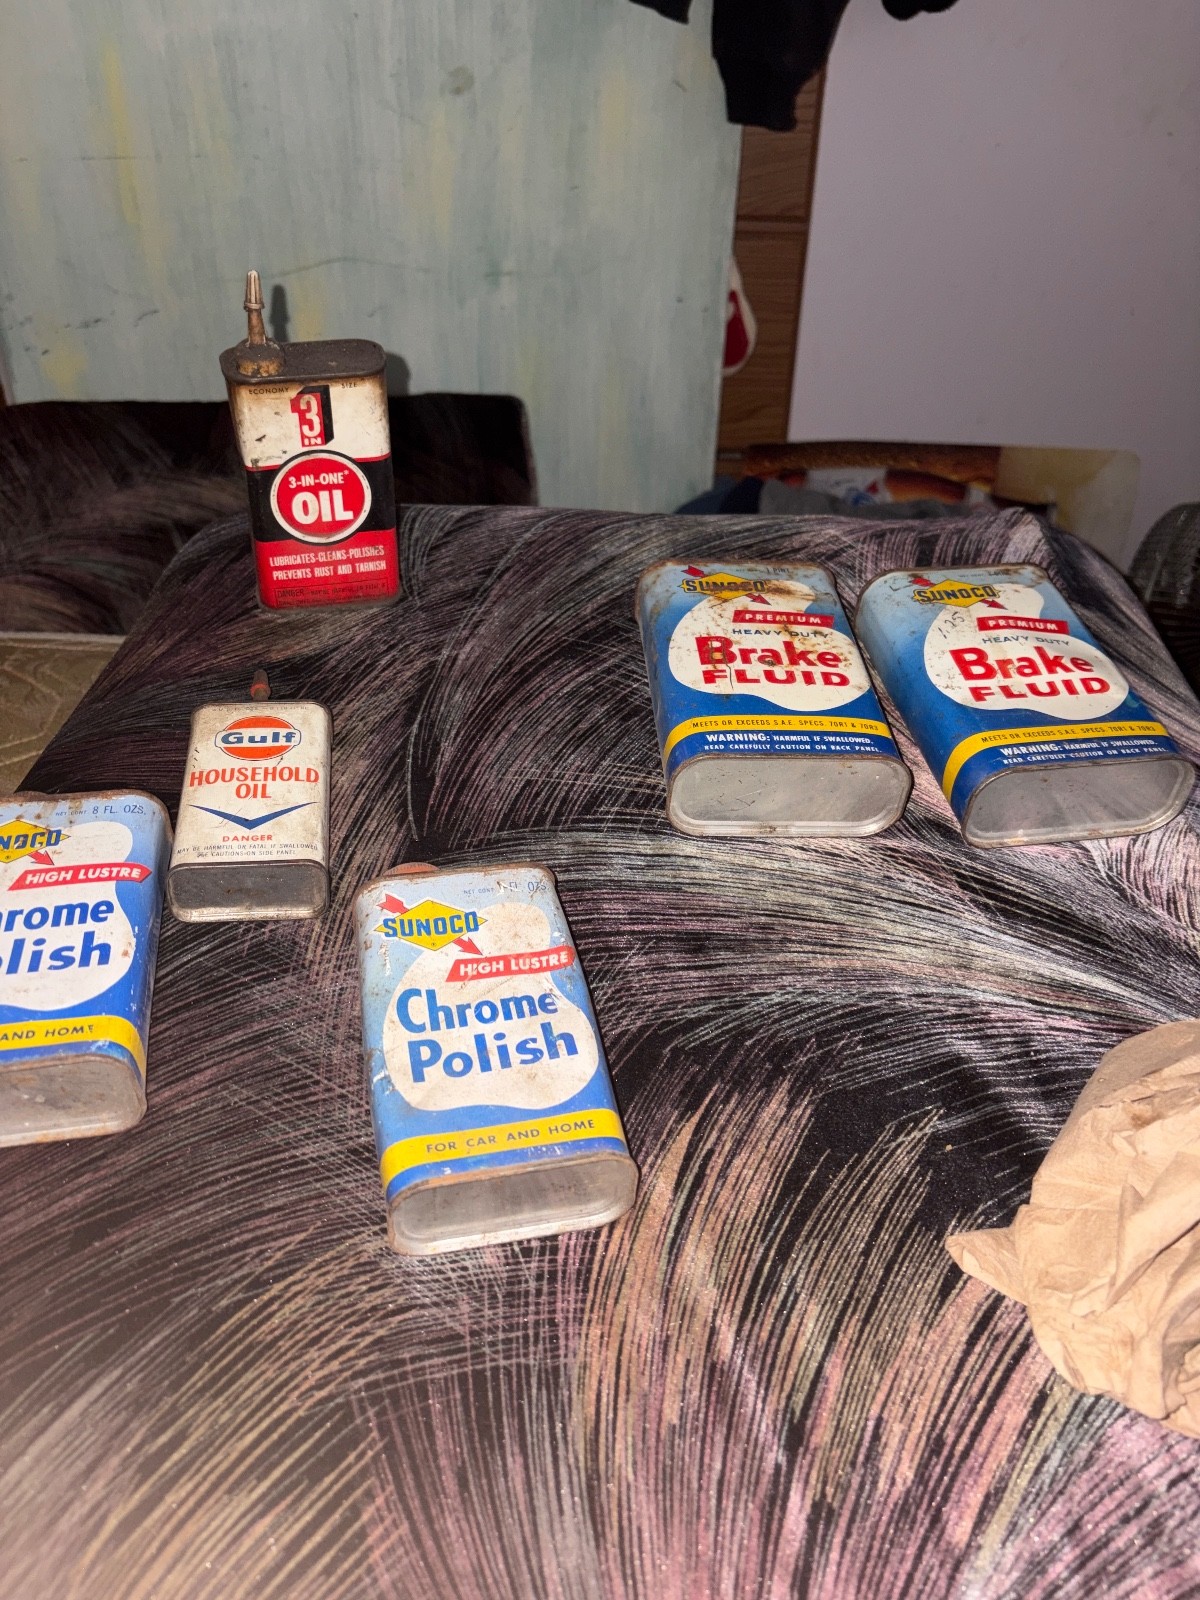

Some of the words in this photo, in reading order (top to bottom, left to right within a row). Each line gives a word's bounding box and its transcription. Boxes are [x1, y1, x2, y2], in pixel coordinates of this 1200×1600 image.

[248, 387, 290, 395] ECONOMY
[303, 438, 322, 446] IN
[291, 489, 354, 525] OIL
[272, 568, 312, 581] PREVENTS
[314, 565, 334, 578] RUST
[337, 564, 352, 575] AND
[355, 560, 387, 573] TARNISH
[683, 578, 767, 593] SUNOCO
[915, 584, 997, 602] SUNOCO
[745, 613, 822, 624] PREMIUM
[988, 618, 1059, 631] PREMIUM
[732, 628, 782, 637] HEAVY
[789, 630, 829, 639] DUTY
[982, 635, 1029, 645] HEAVY
[1034, 636, 1070, 647] DUTY
[695, 635, 842, 669] Brake
[949, 645, 1095, 681] Brake
[702, 669, 850, 687] FLUID
[967, 677, 1111, 702] FLUID
[692, 720, 719, 729] MEETS
[221, 731, 297, 745] Gulf
[706, 732, 771, 742] WARNING:
[823, 736, 874, 744] SWALLOWED.
[981, 734, 1008, 743] MEETS
[1023, 730, 1056, 738] EXCEEDS
[999, 743, 1063, 756] WARNING:
[1063, 742, 1101, 750] HARMFUL
[1002, 757, 1024, 765] READ
[189, 766, 320, 787] HOUSEHOLD
[235, 783, 272, 799] OIL
[92, 805, 99, 814] 8
[103, 804, 119, 814] FL.
[123, 804, 147, 815] OZS.
[222, 834, 273, 842] DANGER
[203, 843, 234, 851] HARMFUL
[279, 842, 319, 851] SWALLOWED
[25, 868, 73, 885] HIGH
[78, 866, 142, 881] LUSTRE
[0, 899, 115, 931] rome
[383, 911, 480, 938] SUNOCO
[0, 930, 112, 974] lish
[459, 960, 504, 977] HIGH
[510, 951, 569, 971] LUSTRE
[396, 987, 559, 1034] Chrome
[0, 1030, 36, 1041] AND
[45, 1024, 94, 1037] HOME
[407, 1022, 580, 1083] Polish
[426, 1142, 458, 1153] FOR
[466, 1134, 497, 1148] CAR
[506, 1128, 541, 1142] AND
[548, 1118, 596, 1135] HOME
